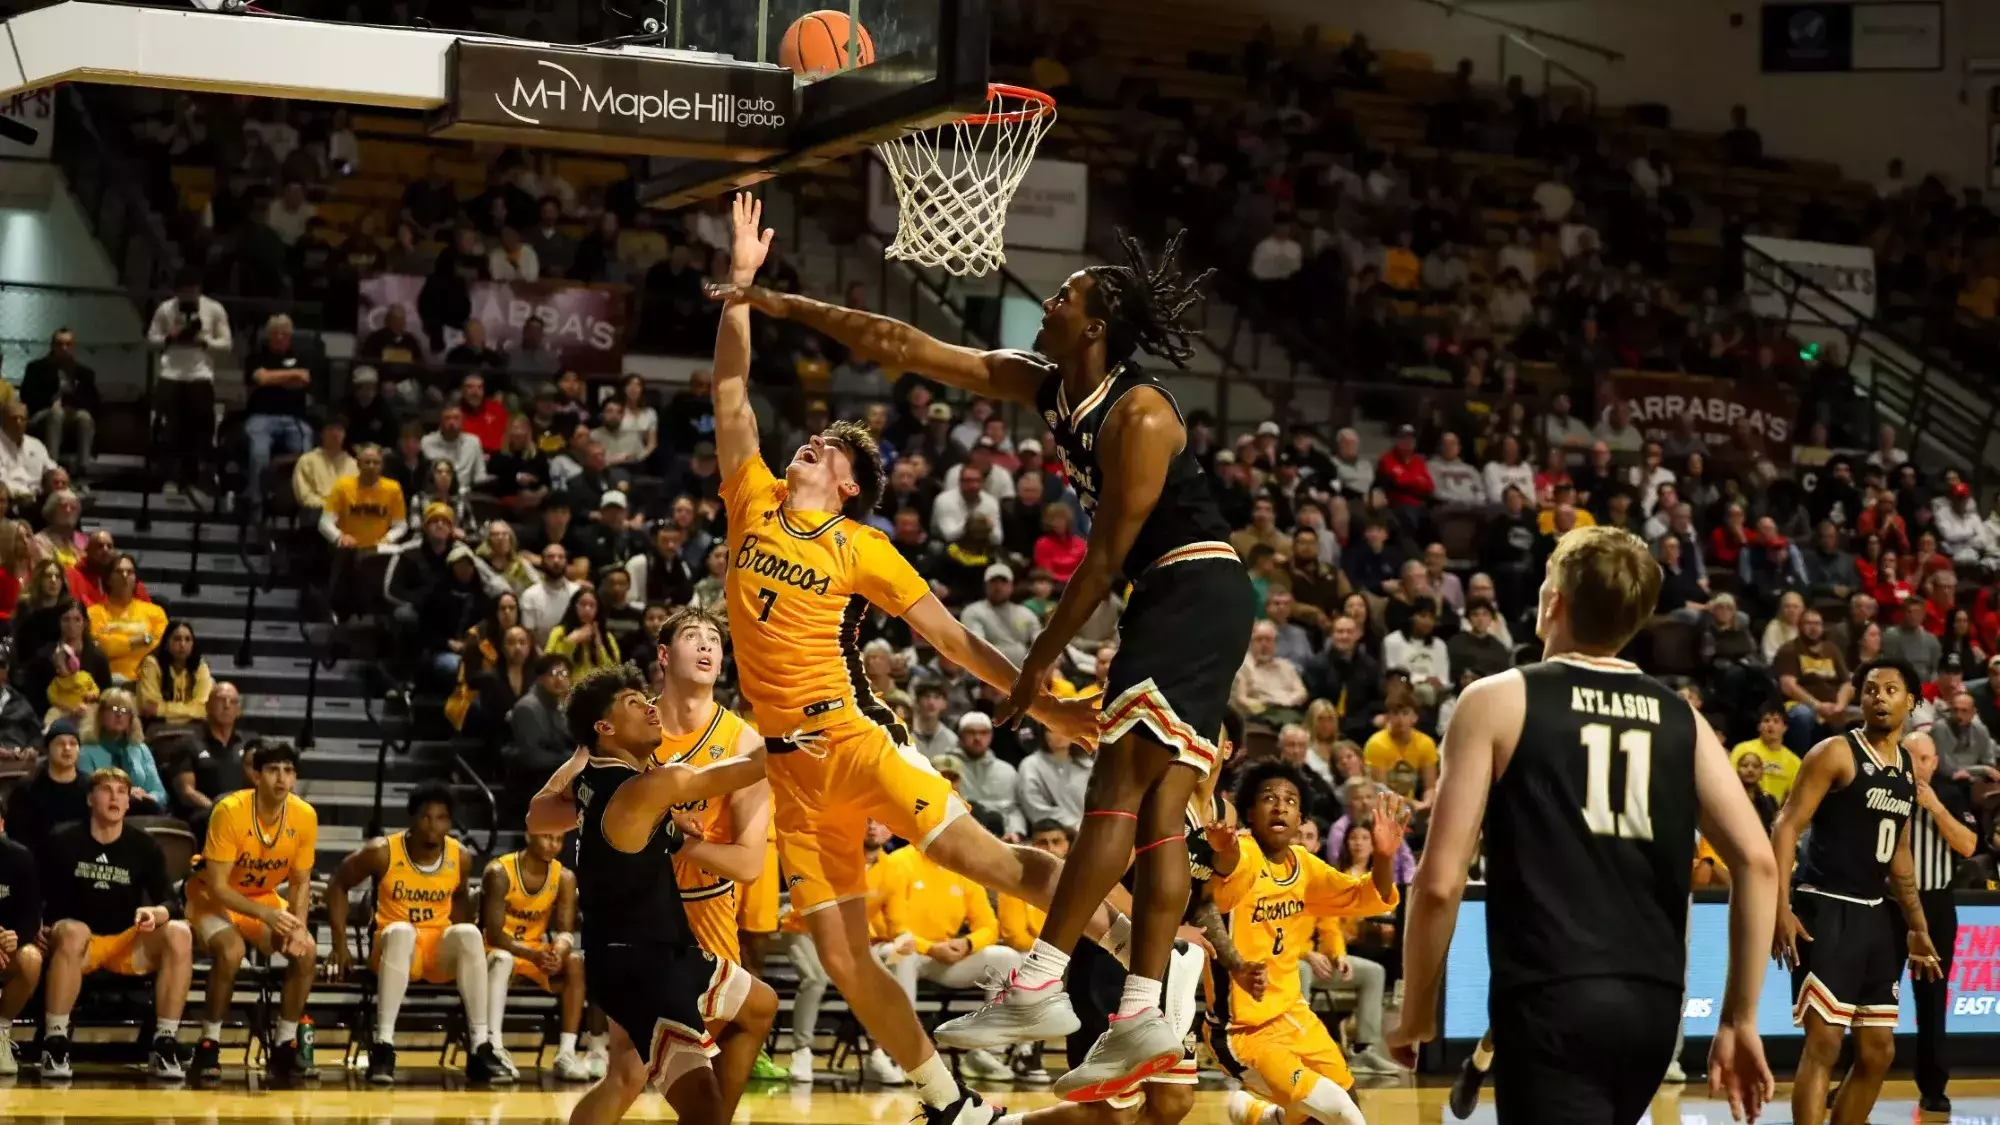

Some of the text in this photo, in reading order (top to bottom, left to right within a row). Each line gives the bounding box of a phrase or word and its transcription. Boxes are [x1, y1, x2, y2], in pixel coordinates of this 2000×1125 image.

[582, 83, 735, 124] Maple Hill
[737, 96, 775, 112] auto
[737, 110, 785, 129] group
[735, 534, 831, 595] Broncos
[757, 587, 778, 623] 7
[1571, 685, 1660, 725] ATLASON
[1580, 722, 1655, 842] 11
[1865, 787, 1913, 817] Miami
[1875, 818, 1896, 864] 0
[1954, 996, 1996, 1015] EAST
